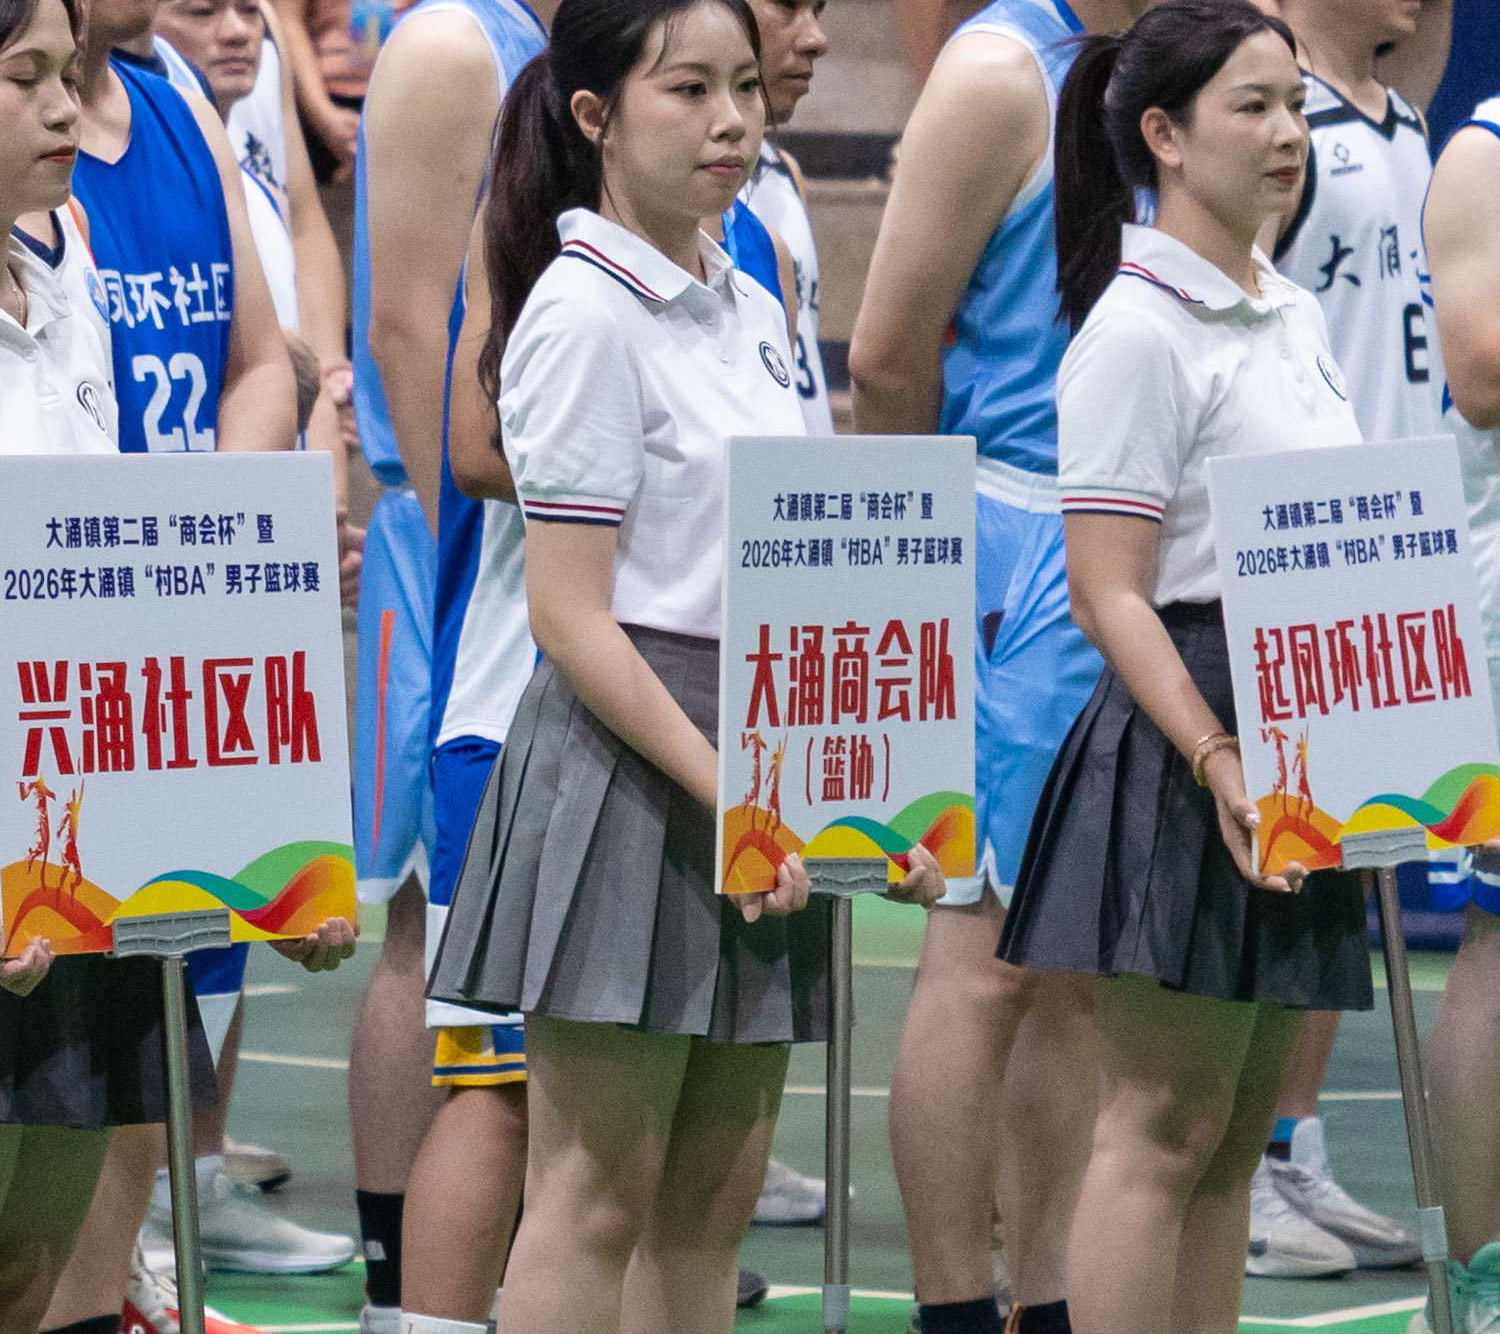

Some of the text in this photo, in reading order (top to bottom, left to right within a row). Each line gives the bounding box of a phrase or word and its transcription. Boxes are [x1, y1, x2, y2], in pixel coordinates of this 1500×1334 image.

[131, 352, 217, 453] 22
[16, 650, 322, 777] 兴涌社区队
[745, 618, 957, 730] 大涌商会队
[1253, 603, 1473, 724] 起凤环社区队
